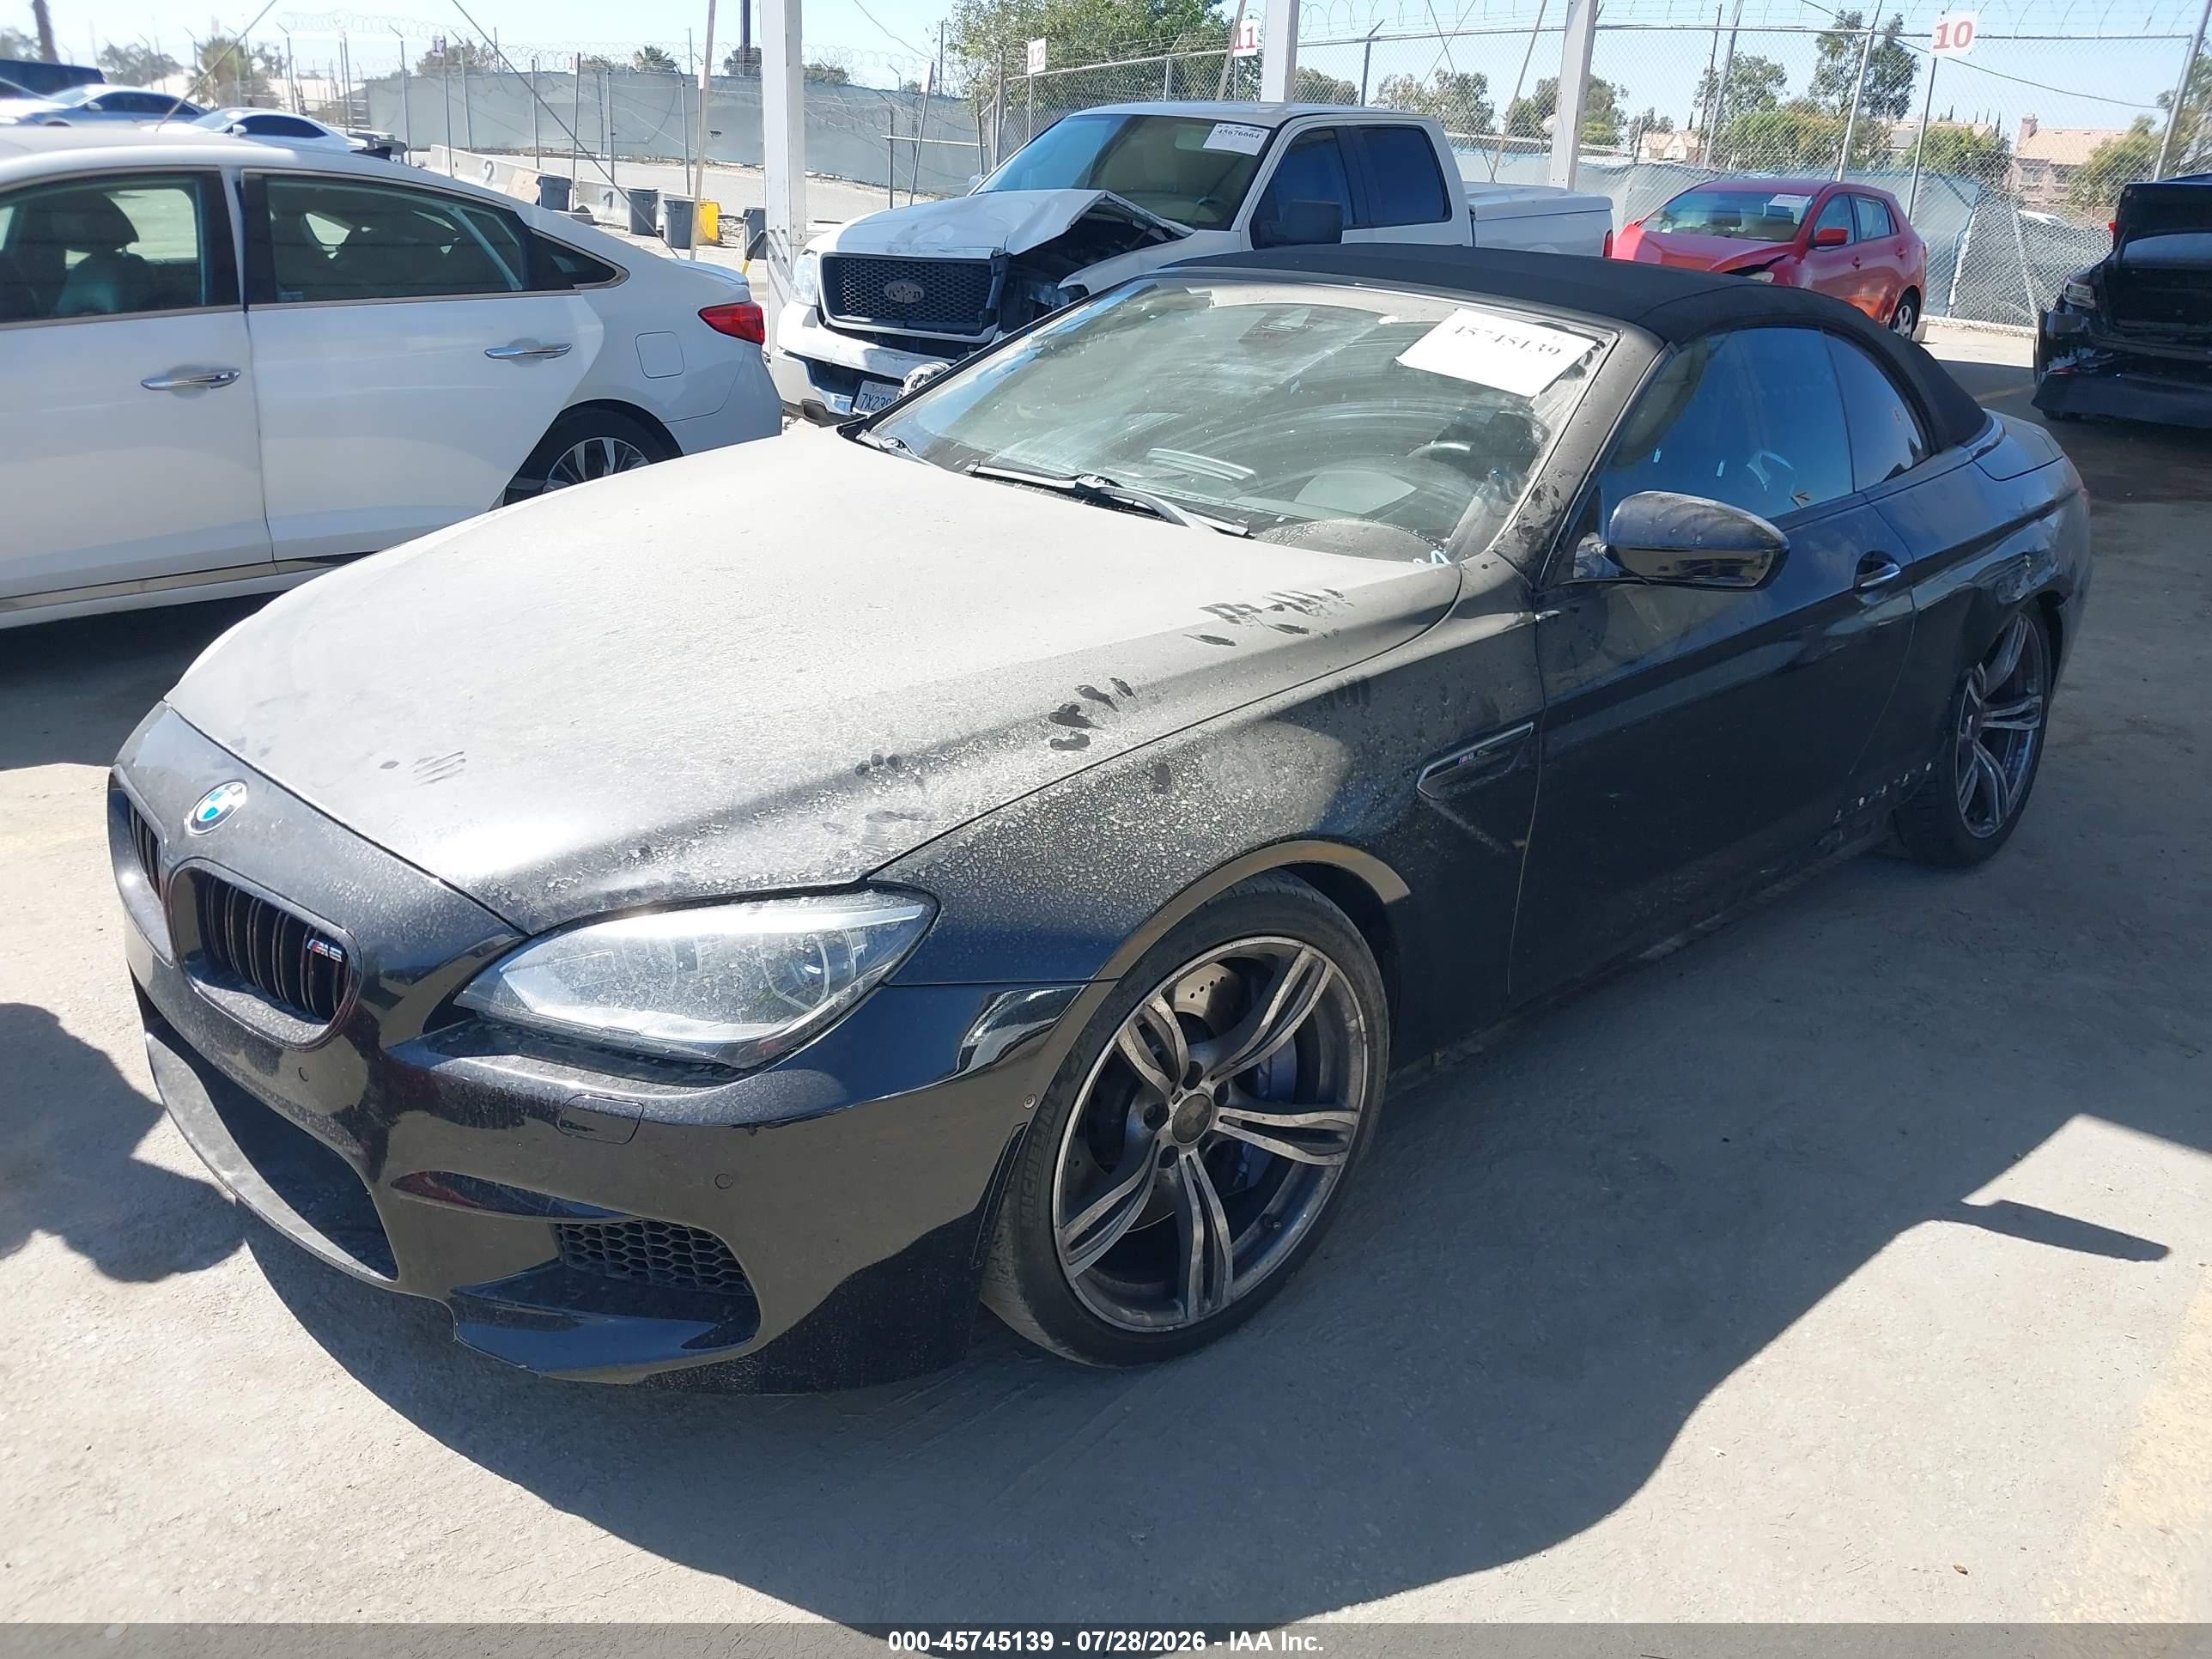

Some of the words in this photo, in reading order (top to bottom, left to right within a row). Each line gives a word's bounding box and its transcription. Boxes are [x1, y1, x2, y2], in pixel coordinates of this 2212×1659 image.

[1234, 26, 1255, 49] 11
[1933, 21, 1973, 49] 10
[1029, 46, 1044, 68] 12
[603, 191, 614, 209] 1
